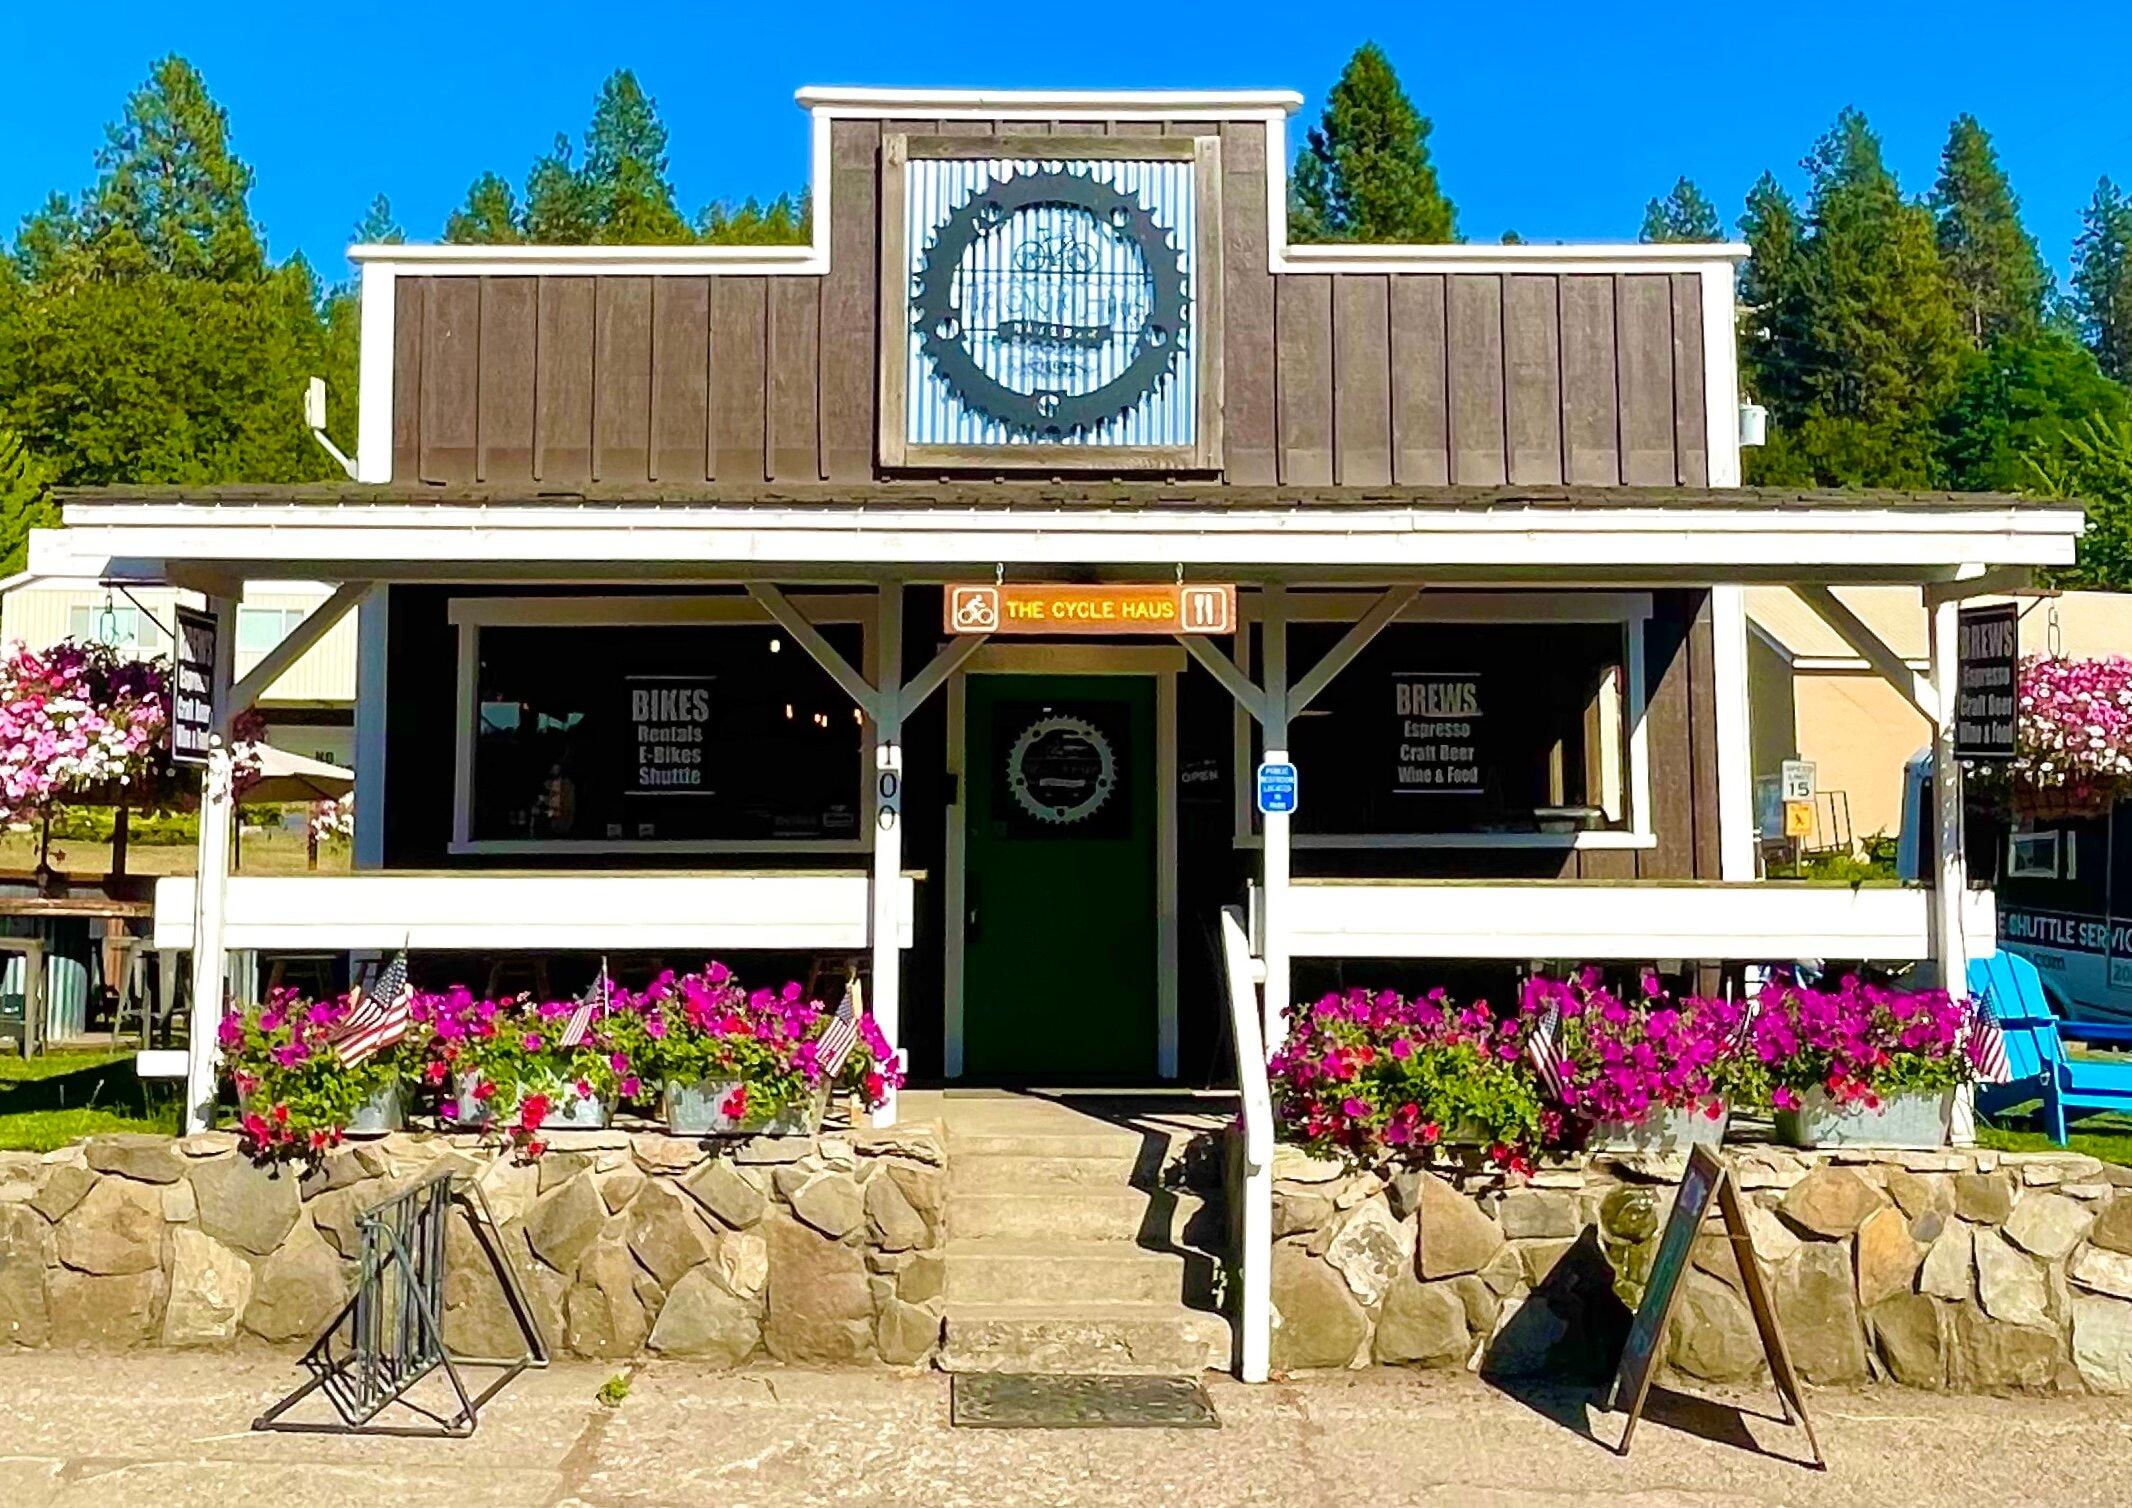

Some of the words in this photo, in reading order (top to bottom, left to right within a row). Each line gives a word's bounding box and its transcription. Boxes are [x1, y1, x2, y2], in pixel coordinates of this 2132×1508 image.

[1007, 601, 1045, 619] THE
[1051, 601, 1116, 619] CYCLE
[1121, 601, 1175, 619] HAUS
[1960, 620, 2013, 660] BREWS
[632, 688, 710, 722] BIKES
[1396, 683, 1479, 716] BREWS
[638, 725, 703, 742] Rentals
[1404, 720, 1471, 738] Espresso
[639, 746, 702, 764] E-Bikes
[1400, 744, 1437, 761] Craft
[1439, 744, 1475, 761] Beer
[639, 767, 701, 785] Shuttle
[1181, 769, 1219, 784] OPEN
[1398, 766, 1432, 783] Wine
[1435, 768, 1444, 783] &
[1447, 766, 1478, 783] Food
[1790, 782, 1809, 797] 15
[2009, 913, 2075, 945] SHUTTLE
